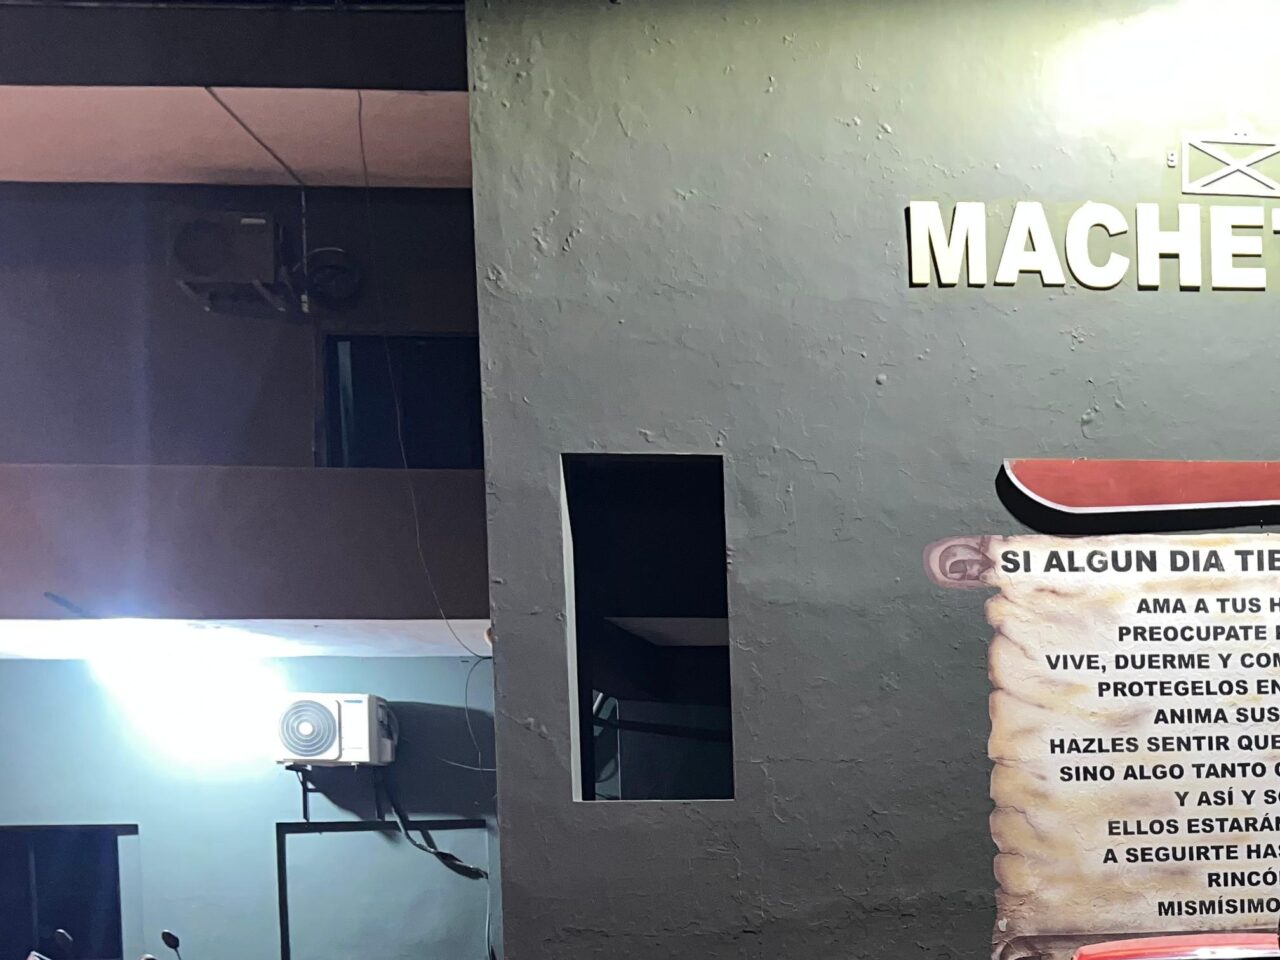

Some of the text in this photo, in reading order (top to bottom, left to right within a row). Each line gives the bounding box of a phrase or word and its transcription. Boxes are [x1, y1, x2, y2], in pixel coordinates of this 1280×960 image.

[1001, 550, 1031, 573] SI
[1044, 550, 1157, 573] ALGUN
[1170, 550, 1225, 572] DIA
[1136, 598, 1186, 614] AMA
[1194, 598, 1209, 613] A
[1216, 597, 1261, 613] TUS
[1118, 625, 1267, 642] PREOCUPATE
[1045, 654, 1106, 673] VIVE,
[1115, 653, 1210, 670] DUERME
[1218, 653, 1232, 669] Y
[1097, 679, 1249, 698] PROTEGELOS
[1153, 708, 1229, 725] ANIMA
[1236, 706, 1280, 723] SUS
[1049, 737, 1139, 754] HAZLES
[1147, 735, 1230, 753] SENTIR
[1059, 765, 1115, 782] SINO
[1123, 763, 1185, 781] ALGO
[1191, 762, 1267, 779] TANTO
[1174, 791, 1190, 807] Y
[1197, 787, 1234, 807] ASÍ
[1241, 789, 1256, 806] Y
[1108, 818, 1179, 836] ELLOS
[1102, 848, 1119, 864] A
[1125, 844, 1239, 863] SEGUIRTE
[1157, 894, 1280, 917] MISMÍSIMO
